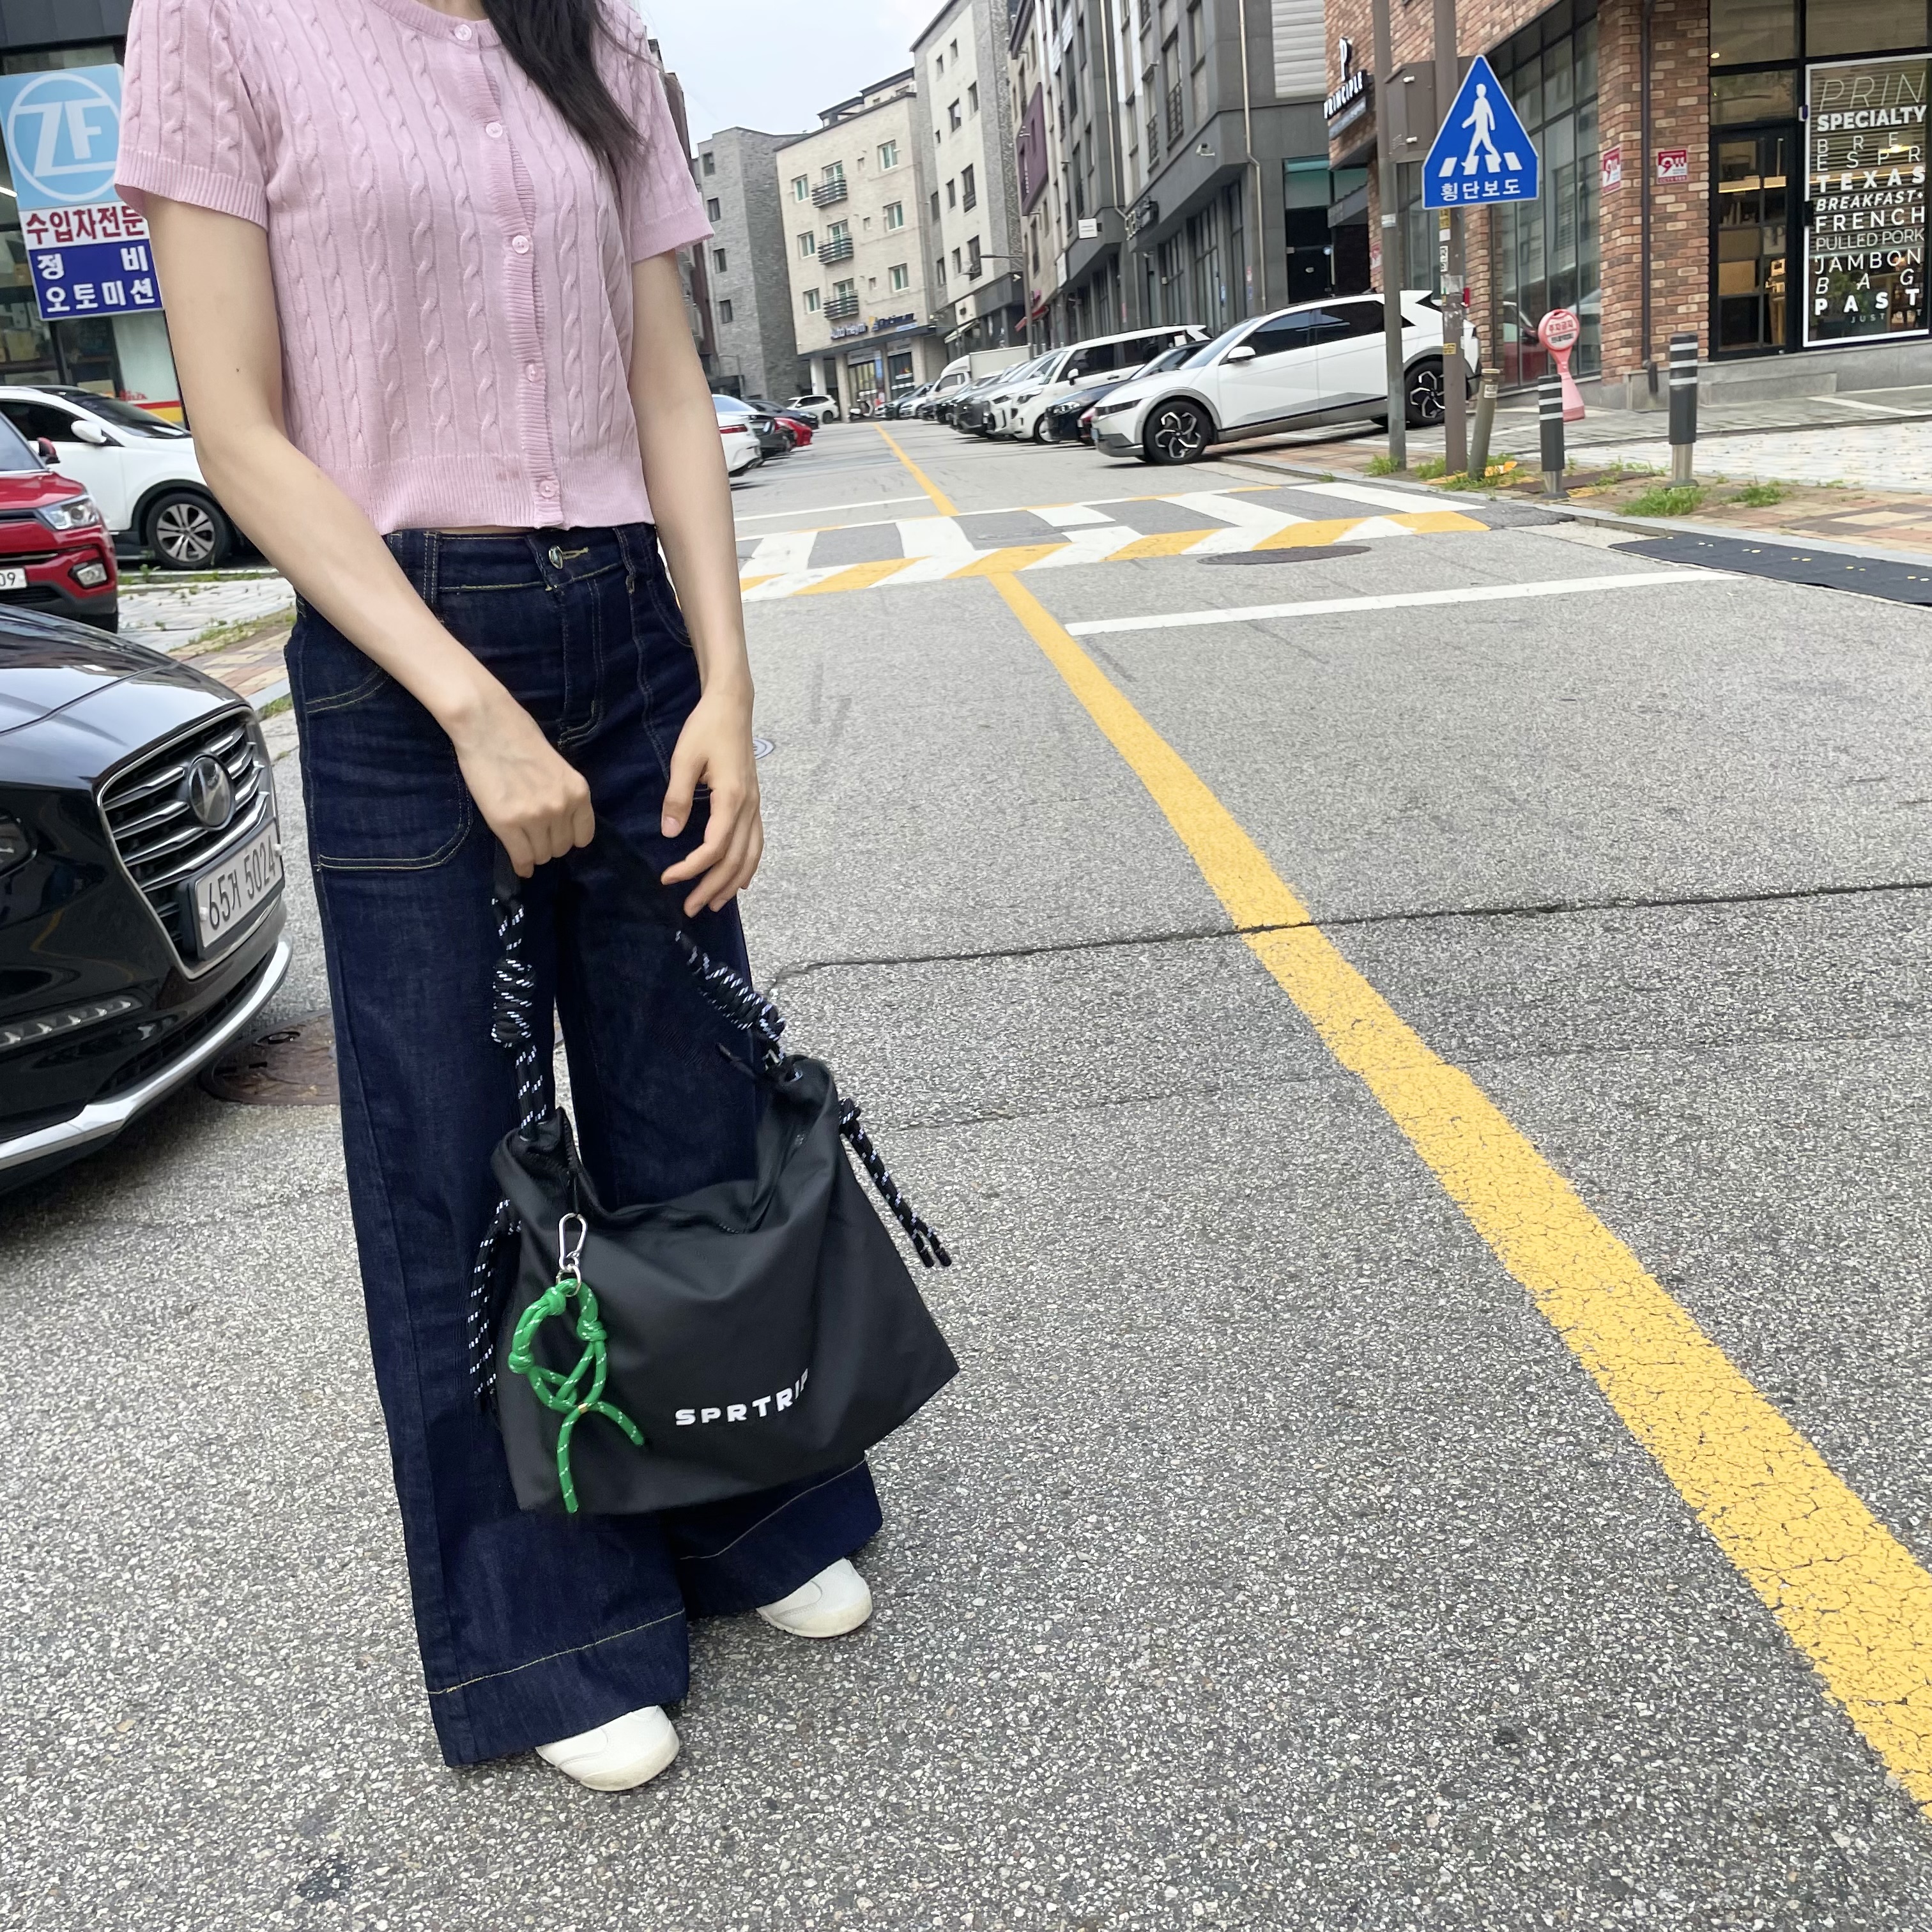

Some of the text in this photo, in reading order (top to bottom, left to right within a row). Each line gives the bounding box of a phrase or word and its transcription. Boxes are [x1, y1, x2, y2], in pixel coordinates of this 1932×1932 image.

[1817, 105, 1927, 132] SPECIALTY
[14, 96, 117, 177] ZF
[1441, 179, 1521, 201] 횡단보도
[1816, 166, 1926, 193] TEXAS
[26, 206, 144, 245] 수입차전문
[1816, 206, 1925, 233] FRENCH
[1816, 227, 1925, 252] PULLED PORK
[1814, 248, 1921, 275] JAMBON
[46, 278, 155, 313] 오토미션
[1851, 313, 1885, 324] JUST
[244, 835, 275, 900] 5024
[675, 1368, 808, 1426] SPRTRIP
